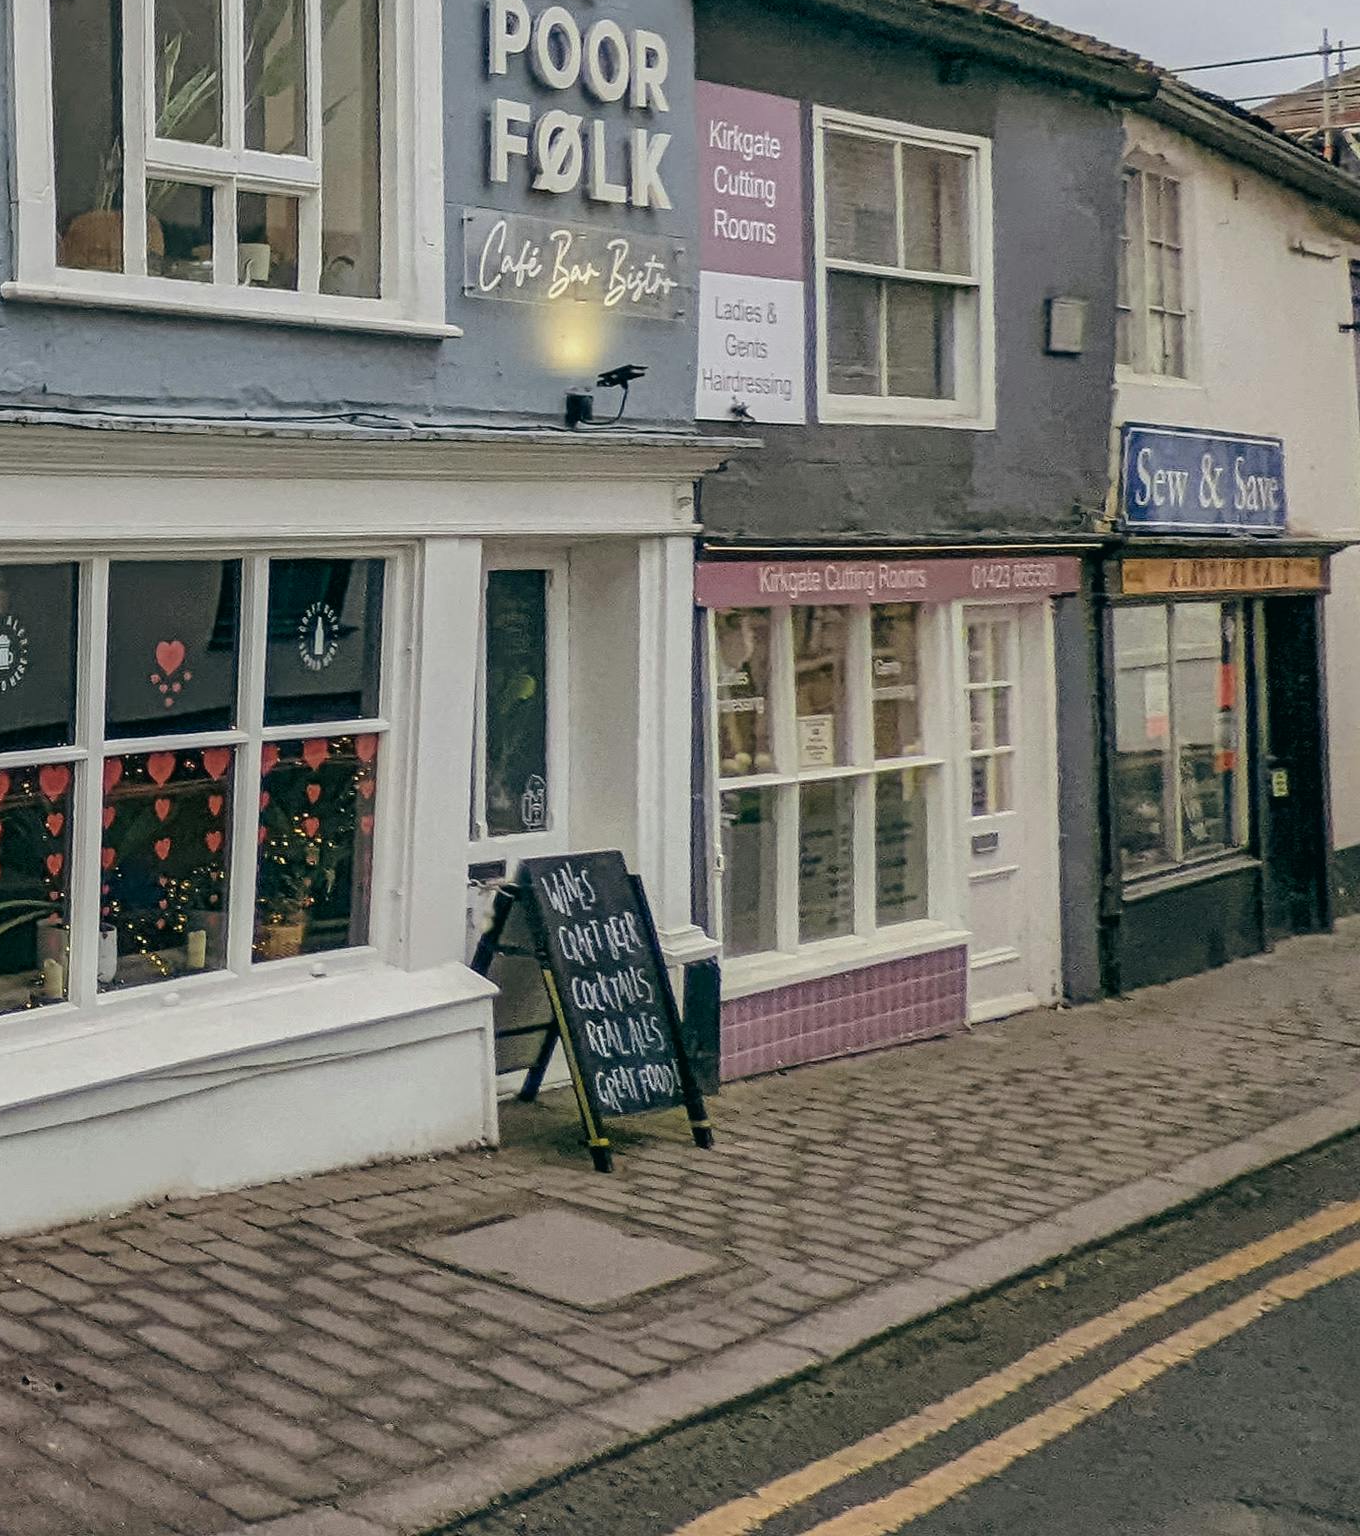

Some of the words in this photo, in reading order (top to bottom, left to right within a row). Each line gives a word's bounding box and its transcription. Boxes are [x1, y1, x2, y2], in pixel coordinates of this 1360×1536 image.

[489, 97, 673, 210] FØLK
[709, 119, 782, 162] Kirkgate
[713, 166, 777, 207] Cutting
[713, 209, 777, 245] Rooms
[478, 220, 544, 292] Café
[547, 229, 600, 300] Bar
[603, 238, 679, 307] Bistro
[714, 296, 763, 323] Ladies
[767, 302, 778, 324] &
[724, 333, 769, 359] Gents
[702, 367, 793, 401] Hairdressing
[1135, 447, 1189, 507] Sew
[1199, 453, 1225, 509] &
[1234, 456, 1279, 510] Save
[759, 566, 821, 599] Kirkgate
[824, 564, 875, 596] Cutting
[879, 563, 927, 589] Rooms
[972, 564, 1010, 589] 01423
[558, 918, 603, 966] CRAFT
[606, 911, 644, 961] BEER
[571, 966, 653, 1012] COCKTAILS
[585, 1017, 630, 1057] REAL
[628, 1012, 665, 1056] ALES
[594, 1065, 639, 1113] GREAT
